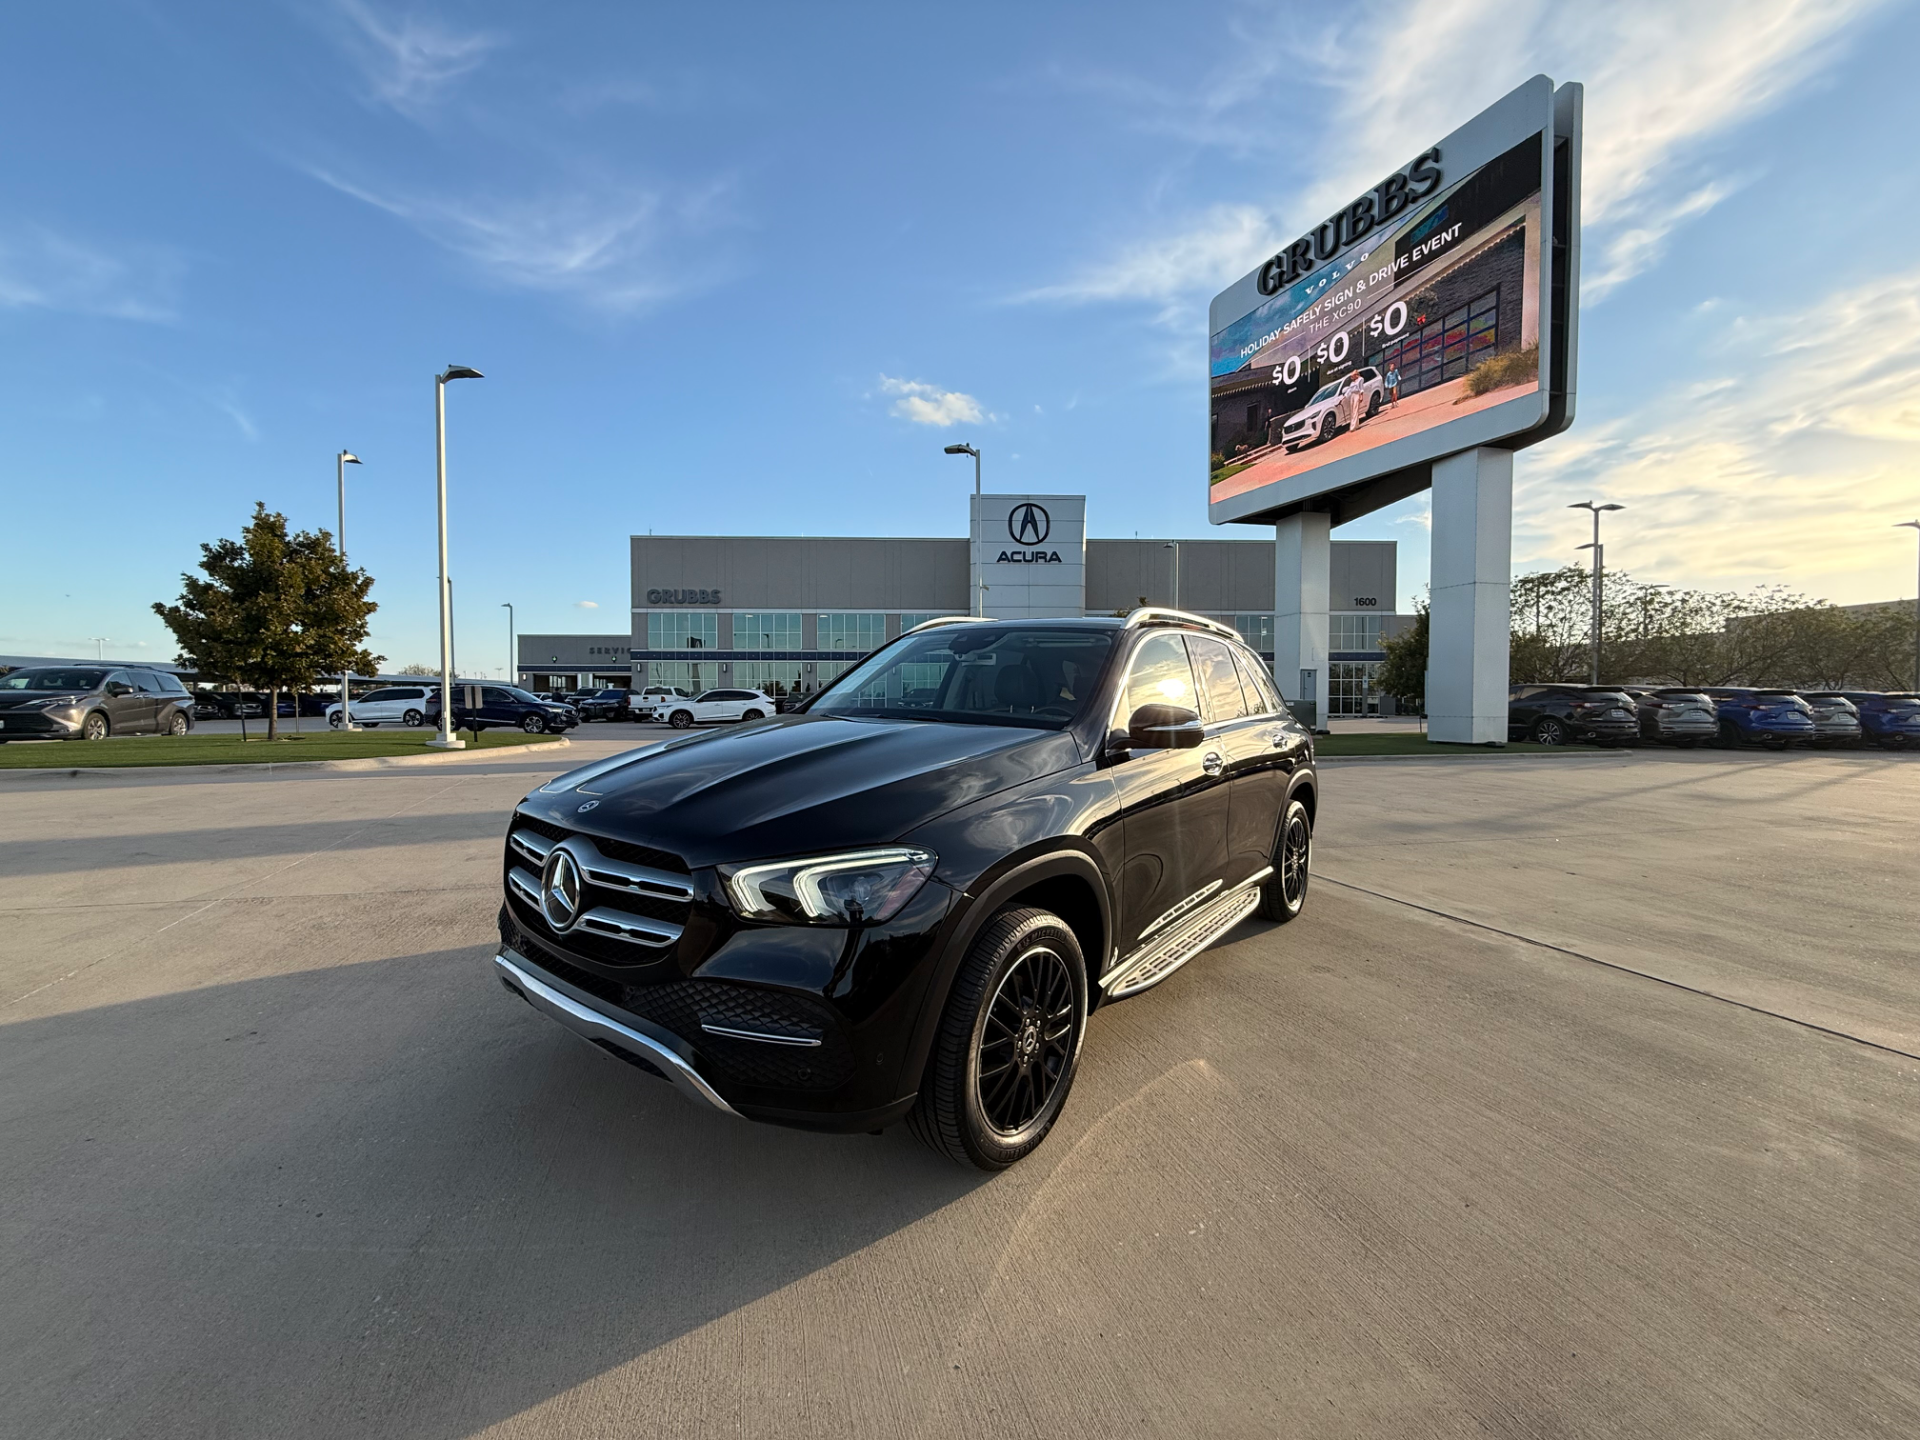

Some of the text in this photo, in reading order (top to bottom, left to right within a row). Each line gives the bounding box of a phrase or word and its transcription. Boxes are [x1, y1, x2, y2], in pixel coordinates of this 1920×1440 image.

[1257, 147, 1442, 296] GRUBBS
[1240, 222, 1463, 358] HOLIDAY SAFELY SIGN & DRIVE EVENT
[1305, 252, 1369, 294] VOLVO
[1309, 298, 1362, 334] THE XC90
[1370, 300, 1408, 338] $0
[1316, 331, 1350, 365] $0
[1272, 355, 1302, 386] $0
[996, 550, 1063, 563] ACURA
[646, 588, 722, 605] GRUBBS
[1353, 597, 1377, 606] 1600
